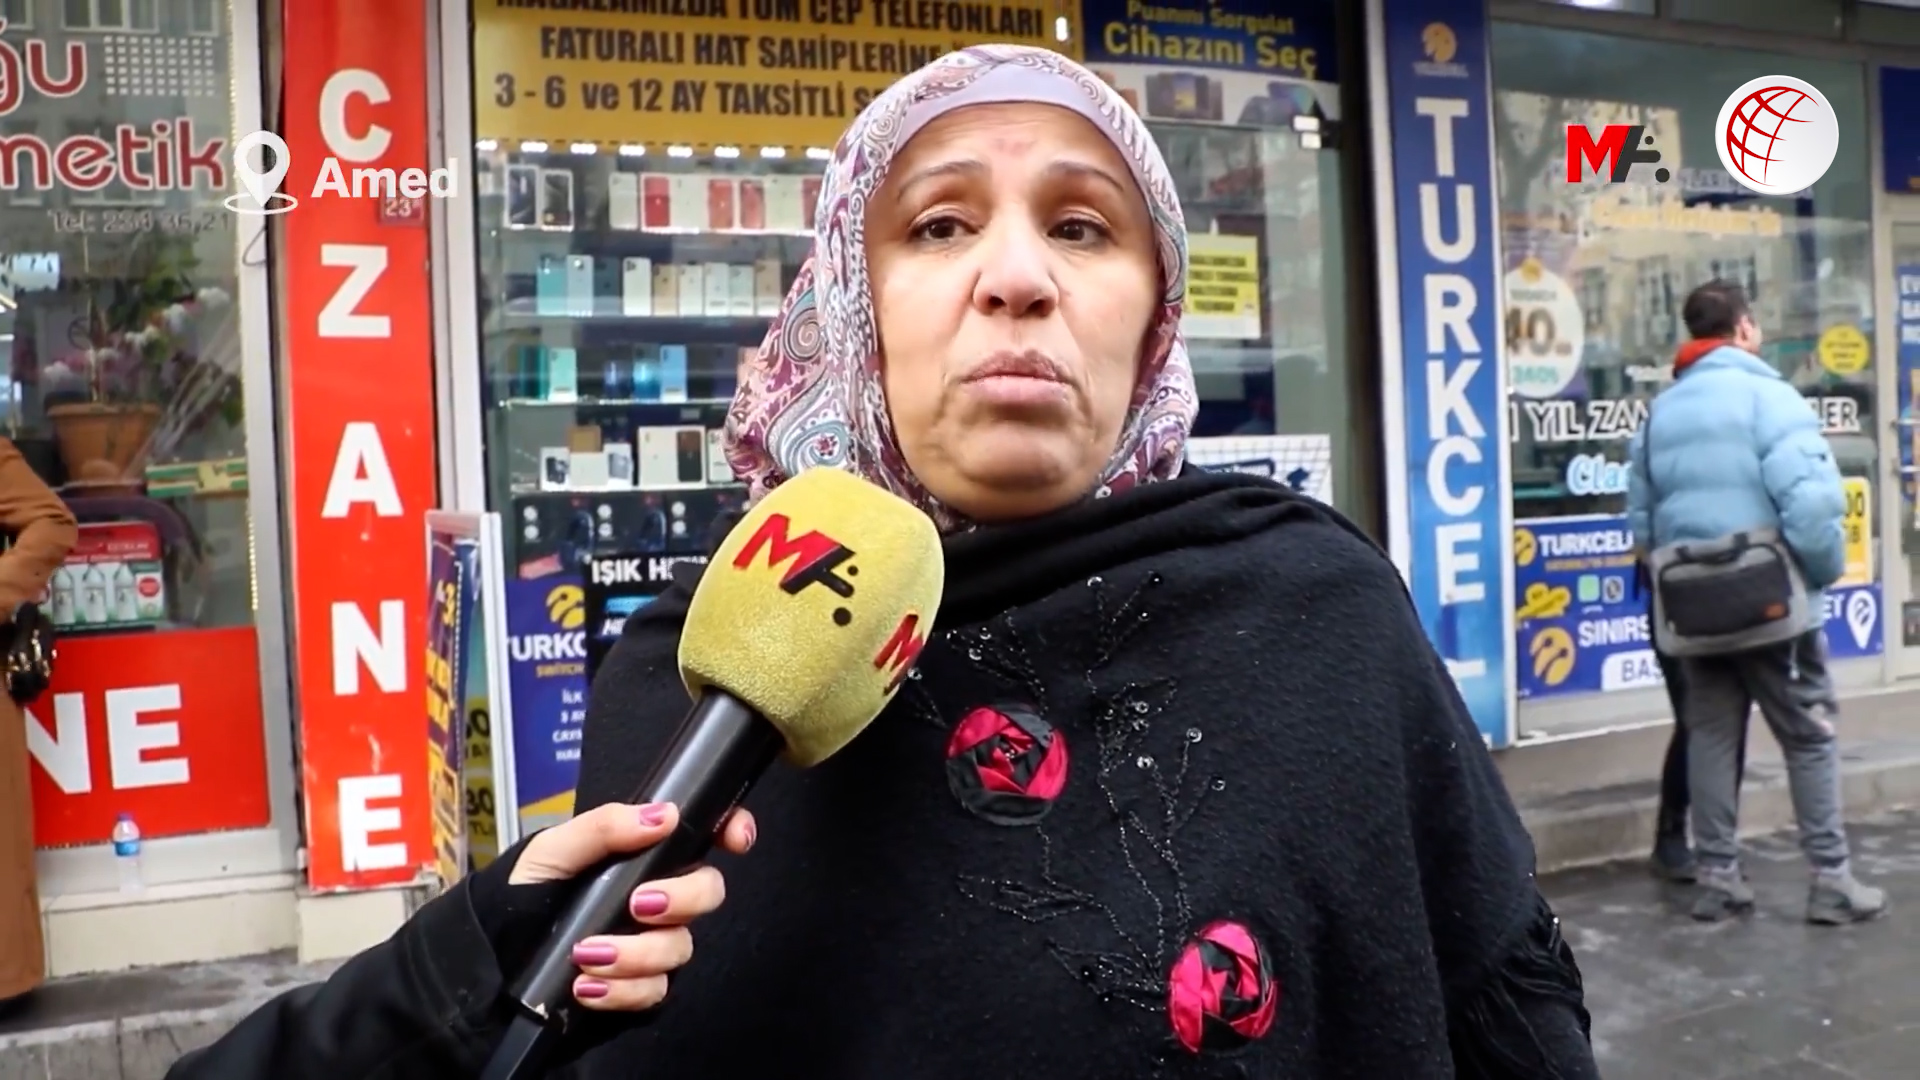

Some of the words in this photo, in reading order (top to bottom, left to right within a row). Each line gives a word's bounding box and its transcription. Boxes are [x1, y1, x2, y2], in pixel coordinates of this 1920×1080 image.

[871, 0, 1043, 37] TELEFONLARI
[540, 26, 684, 64] FATURALI
[694, 33, 751, 67] HAT
[1103, 22, 1244, 64] Cihazını
[1256, 35, 1318, 80] Seç
[494, 73, 516, 108] 3
[544, 75, 566, 109] 6
[581, 82, 620, 110] ve
[627, 78, 662, 112] 12
[671, 80, 707, 113] AY
[714, 80, 845, 118] TAKSİTLİ
[1414, 97, 1492, 750] TURKCEL
[592, 558, 642, 587] IŞIK
